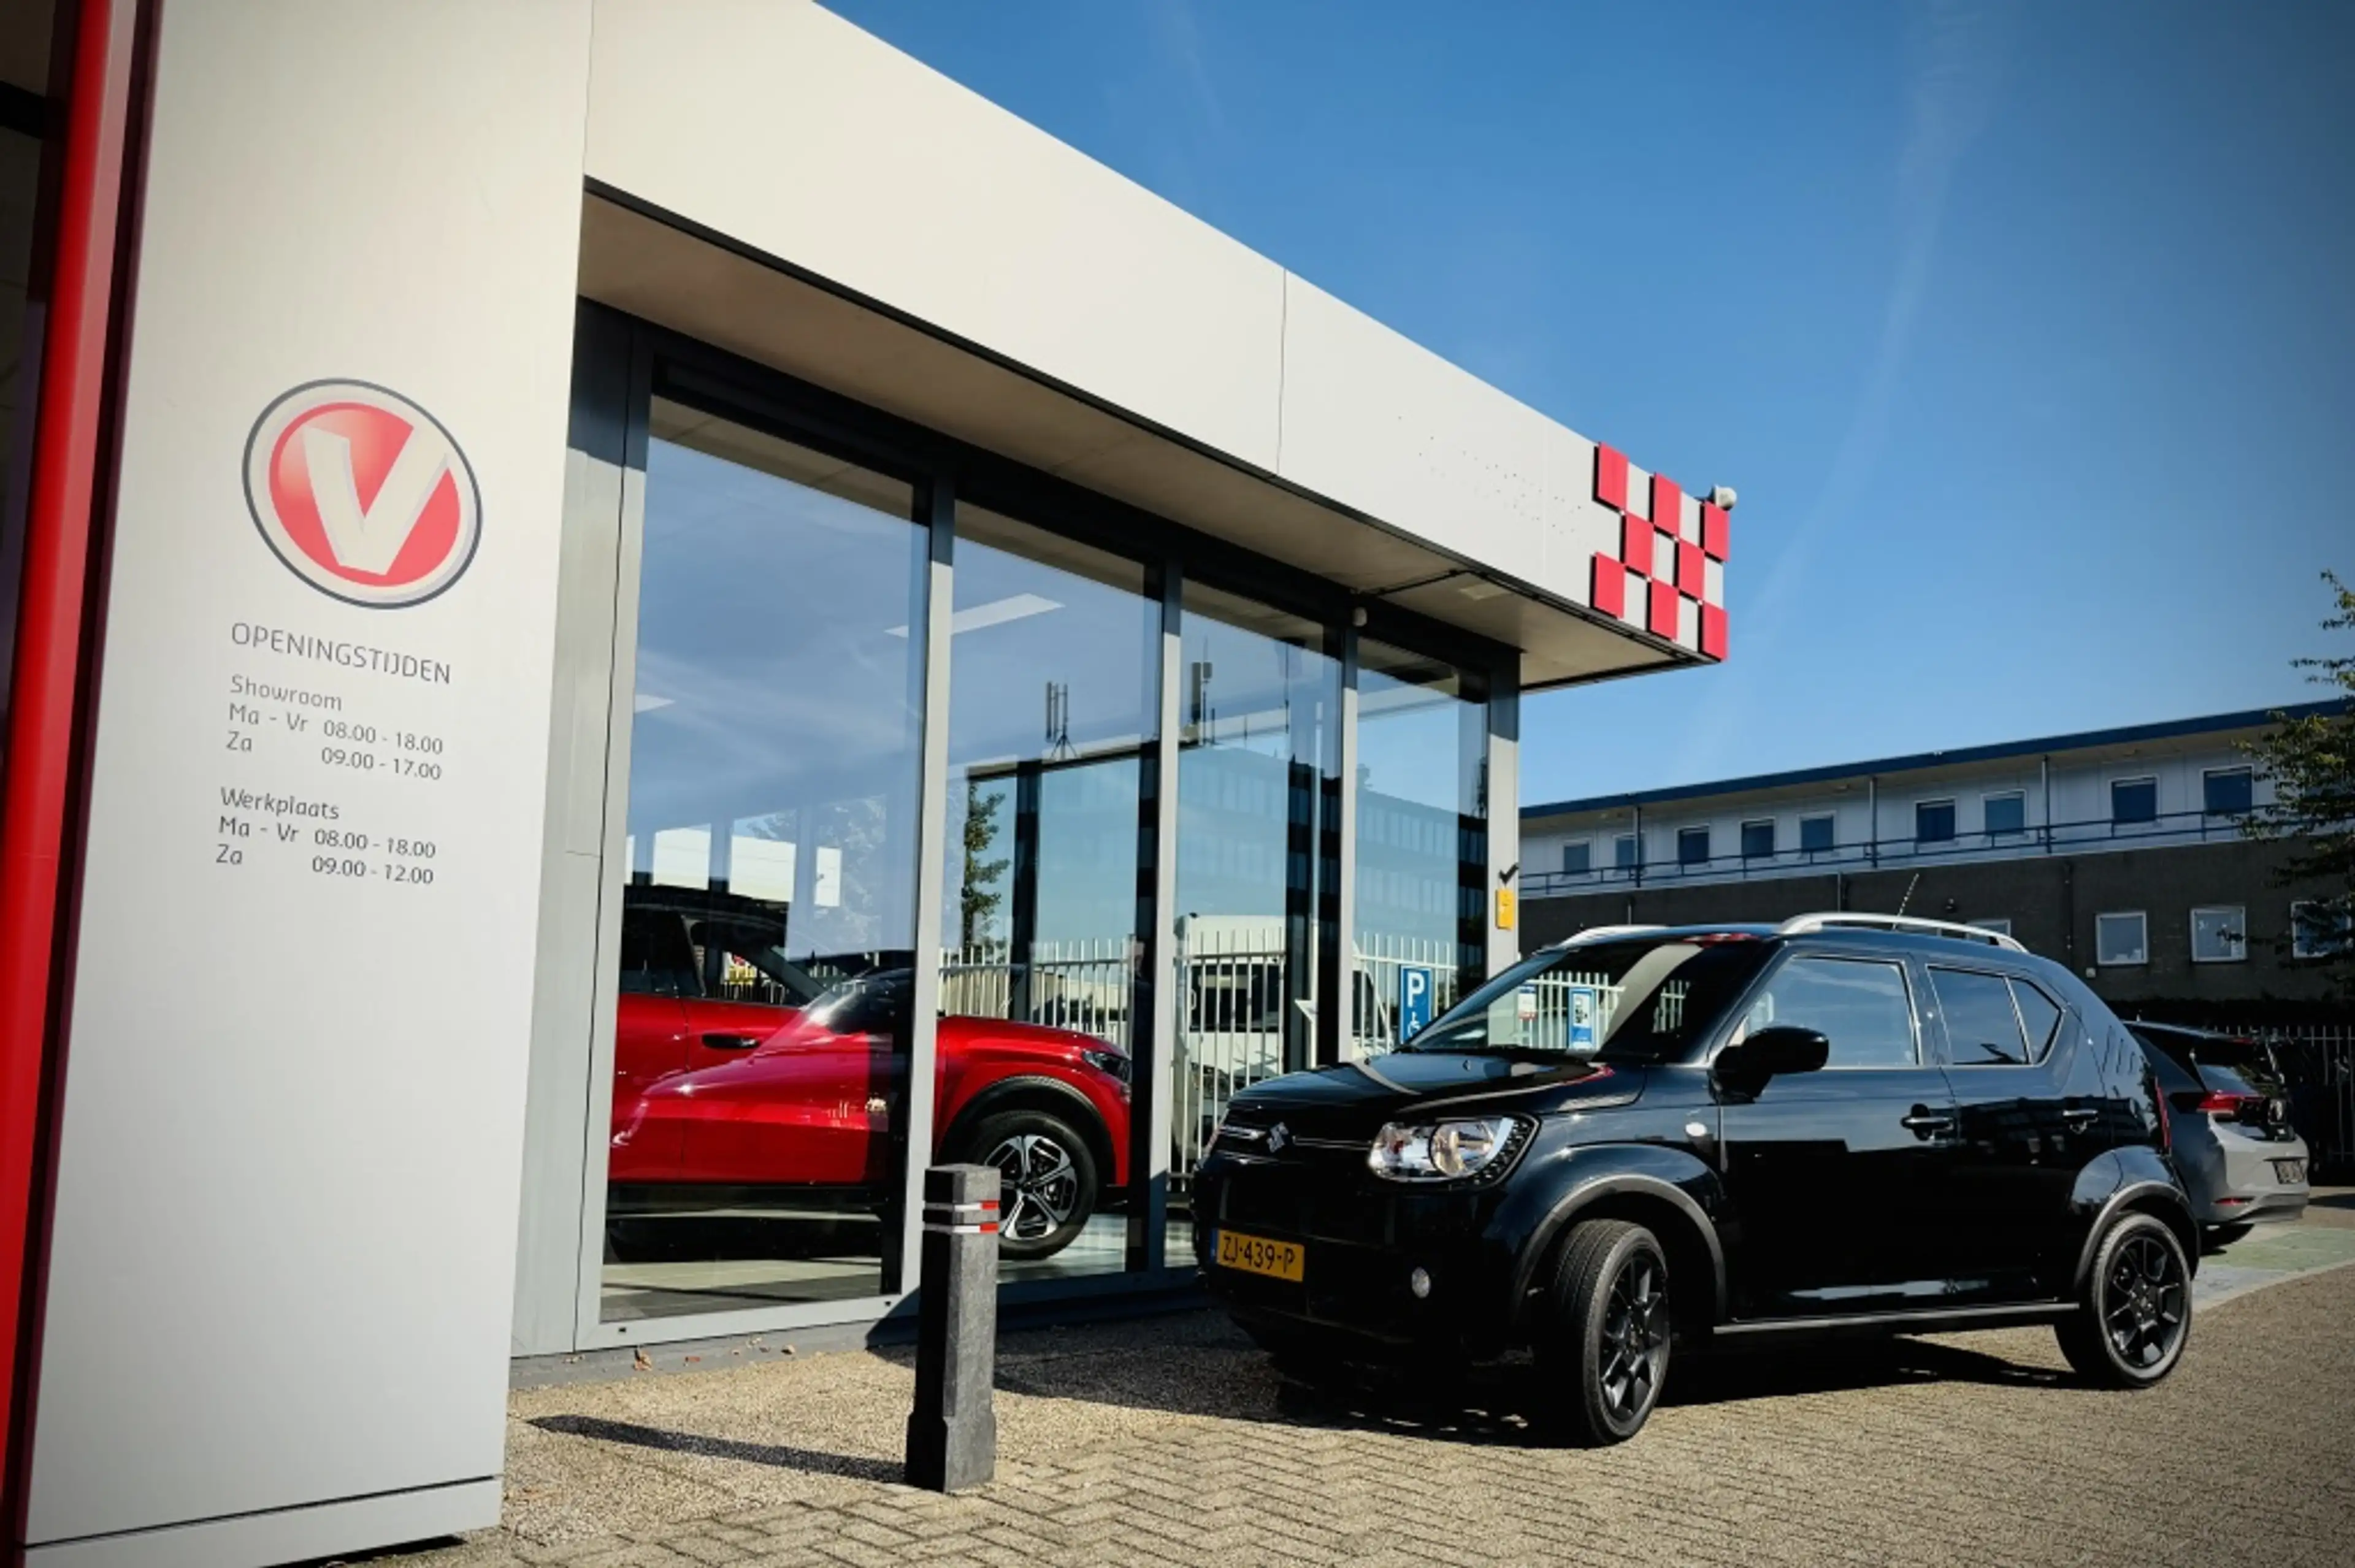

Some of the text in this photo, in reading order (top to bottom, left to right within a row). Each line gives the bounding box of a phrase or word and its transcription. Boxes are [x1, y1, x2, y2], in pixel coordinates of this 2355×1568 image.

[231, 622, 451, 685] OPENINGSTIJDEN
[229, 673, 343, 712] Showroom
[229, 702, 260, 726] Ma
[286, 711, 309, 733] Vr
[323, 719, 377, 744] 08.00
[396, 731, 443, 755] 18.00
[226, 730, 253, 753] Za
[321, 746, 375, 771] 09.00
[392, 757, 442, 781] 17.00
[220, 786, 340, 820] Werkplaats
[218, 814, 251, 838] Ma
[276, 822, 301, 843] Vr
[314, 828, 369, 851] 08.00
[386, 836, 436, 860] 18.00
[215, 843, 243, 866] Za
[312, 855, 367, 878] 09.00
[384, 863, 434, 885] 12.00
[1407, 973, 1425, 1008] P
[1223, 1236, 1295, 1274] ZJ-439-P
